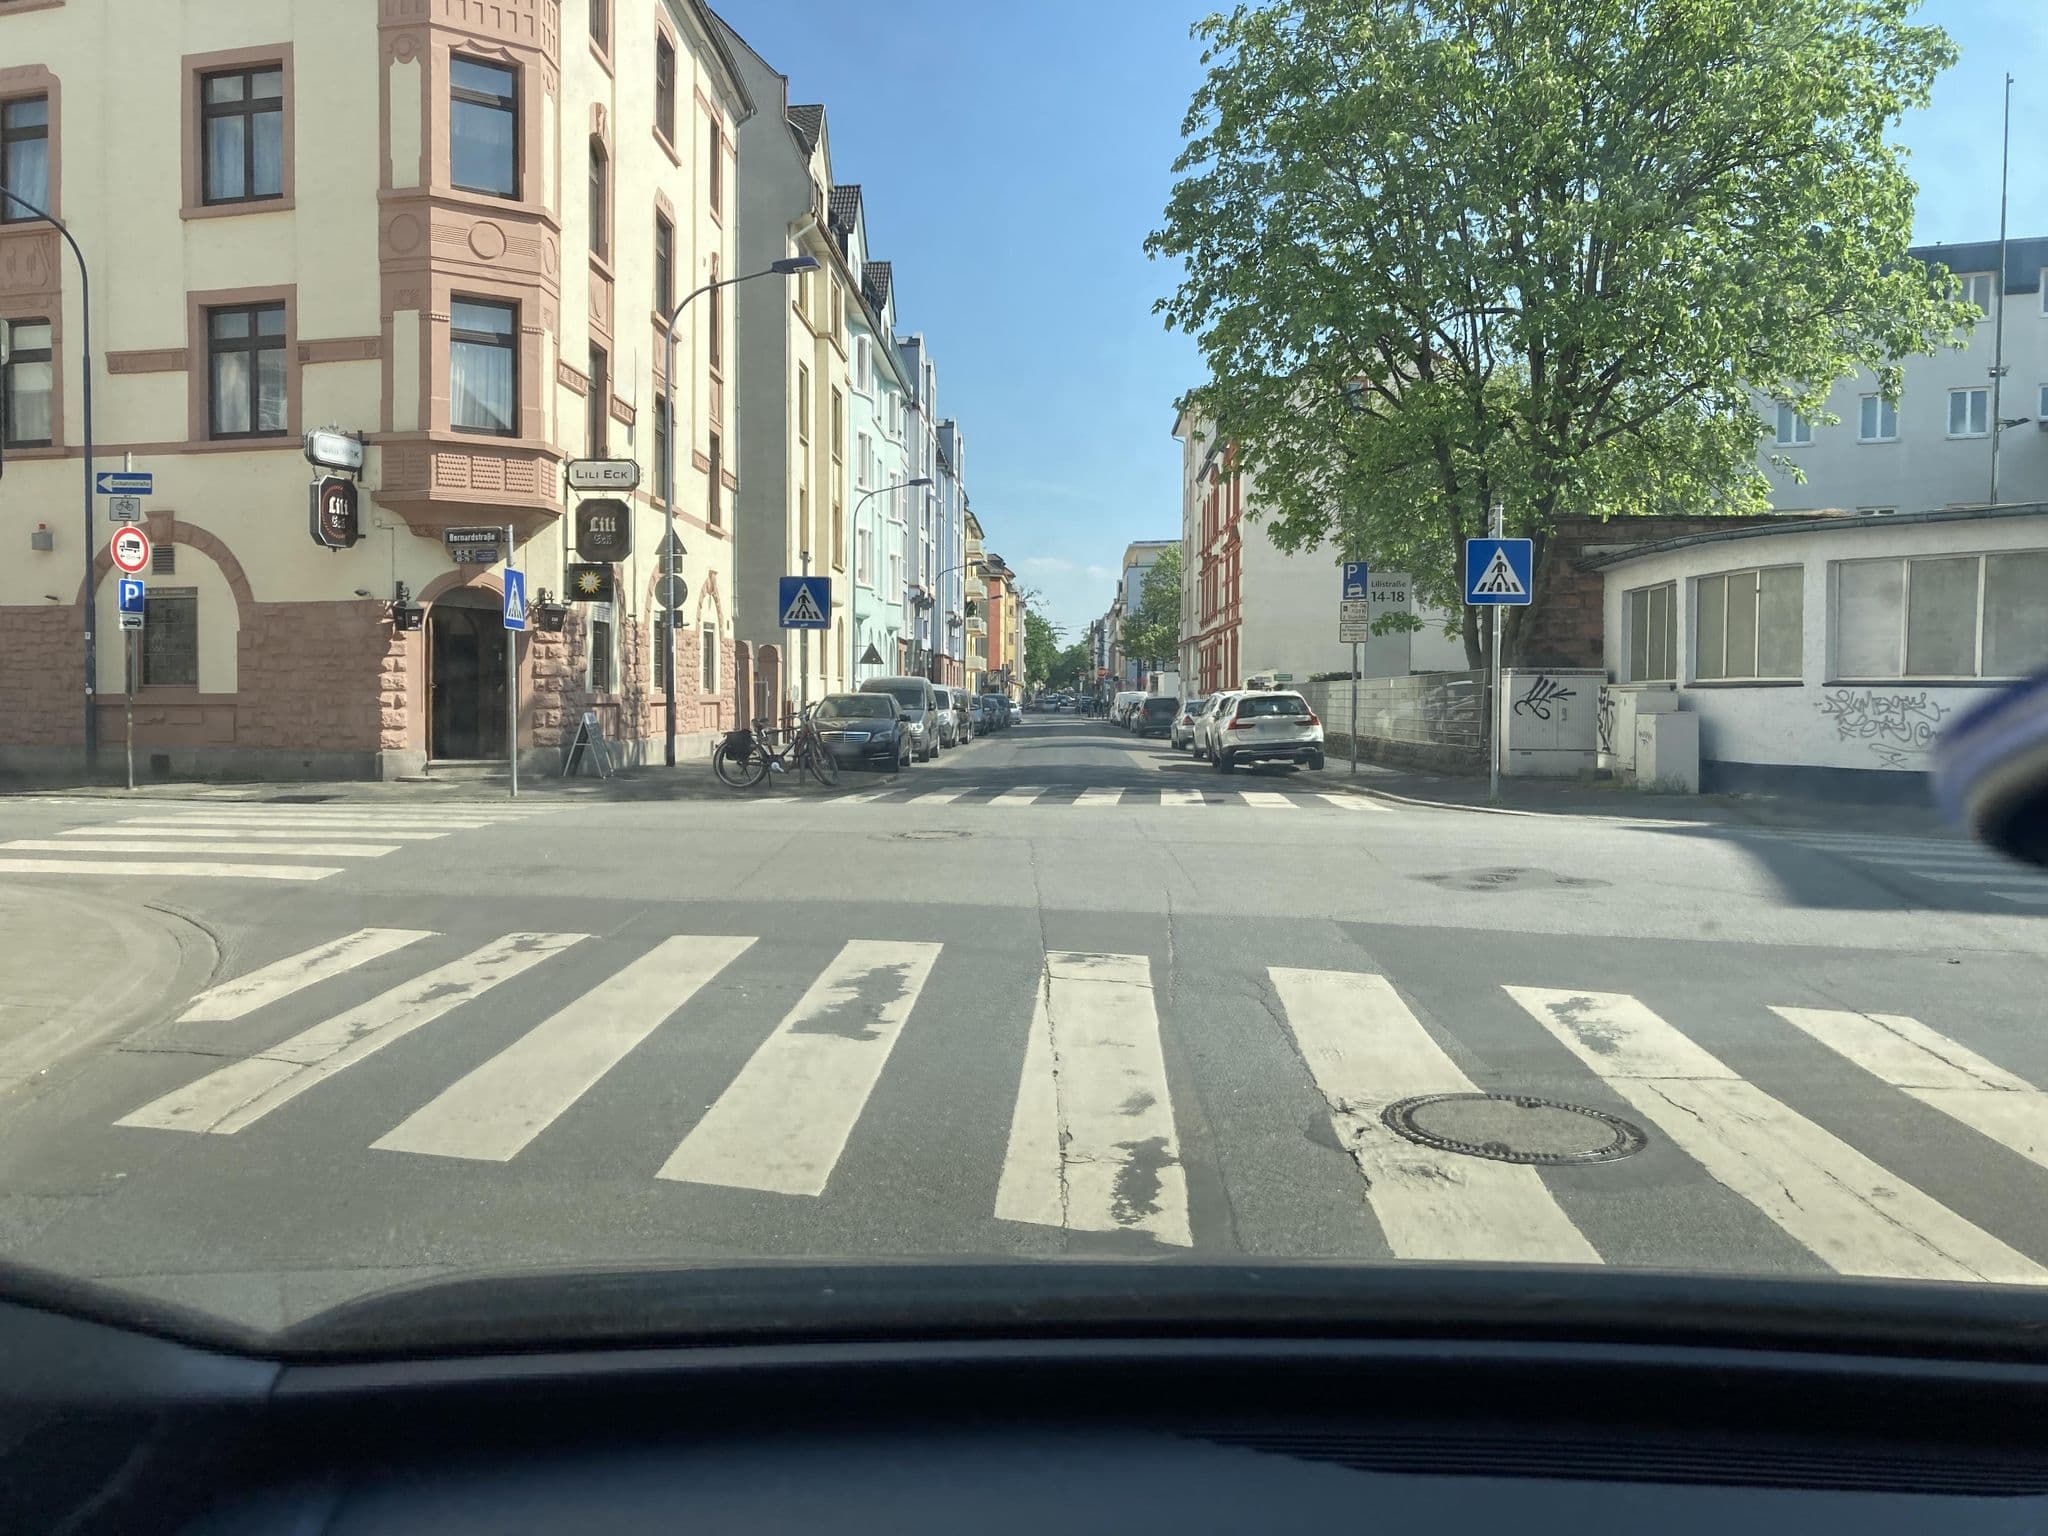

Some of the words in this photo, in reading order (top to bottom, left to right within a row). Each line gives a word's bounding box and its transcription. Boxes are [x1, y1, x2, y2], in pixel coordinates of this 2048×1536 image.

[603, 469, 628, 479] ECK
[328, 496, 349, 515] Lili
[589, 516, 616, 532] Lili
[1347, 564, 1358, 580] P
[1371, 580, 1407, 588] Lilistraße
[124, 583, 139, 608] P
[1371, 591, 1405, 603] 14-18
